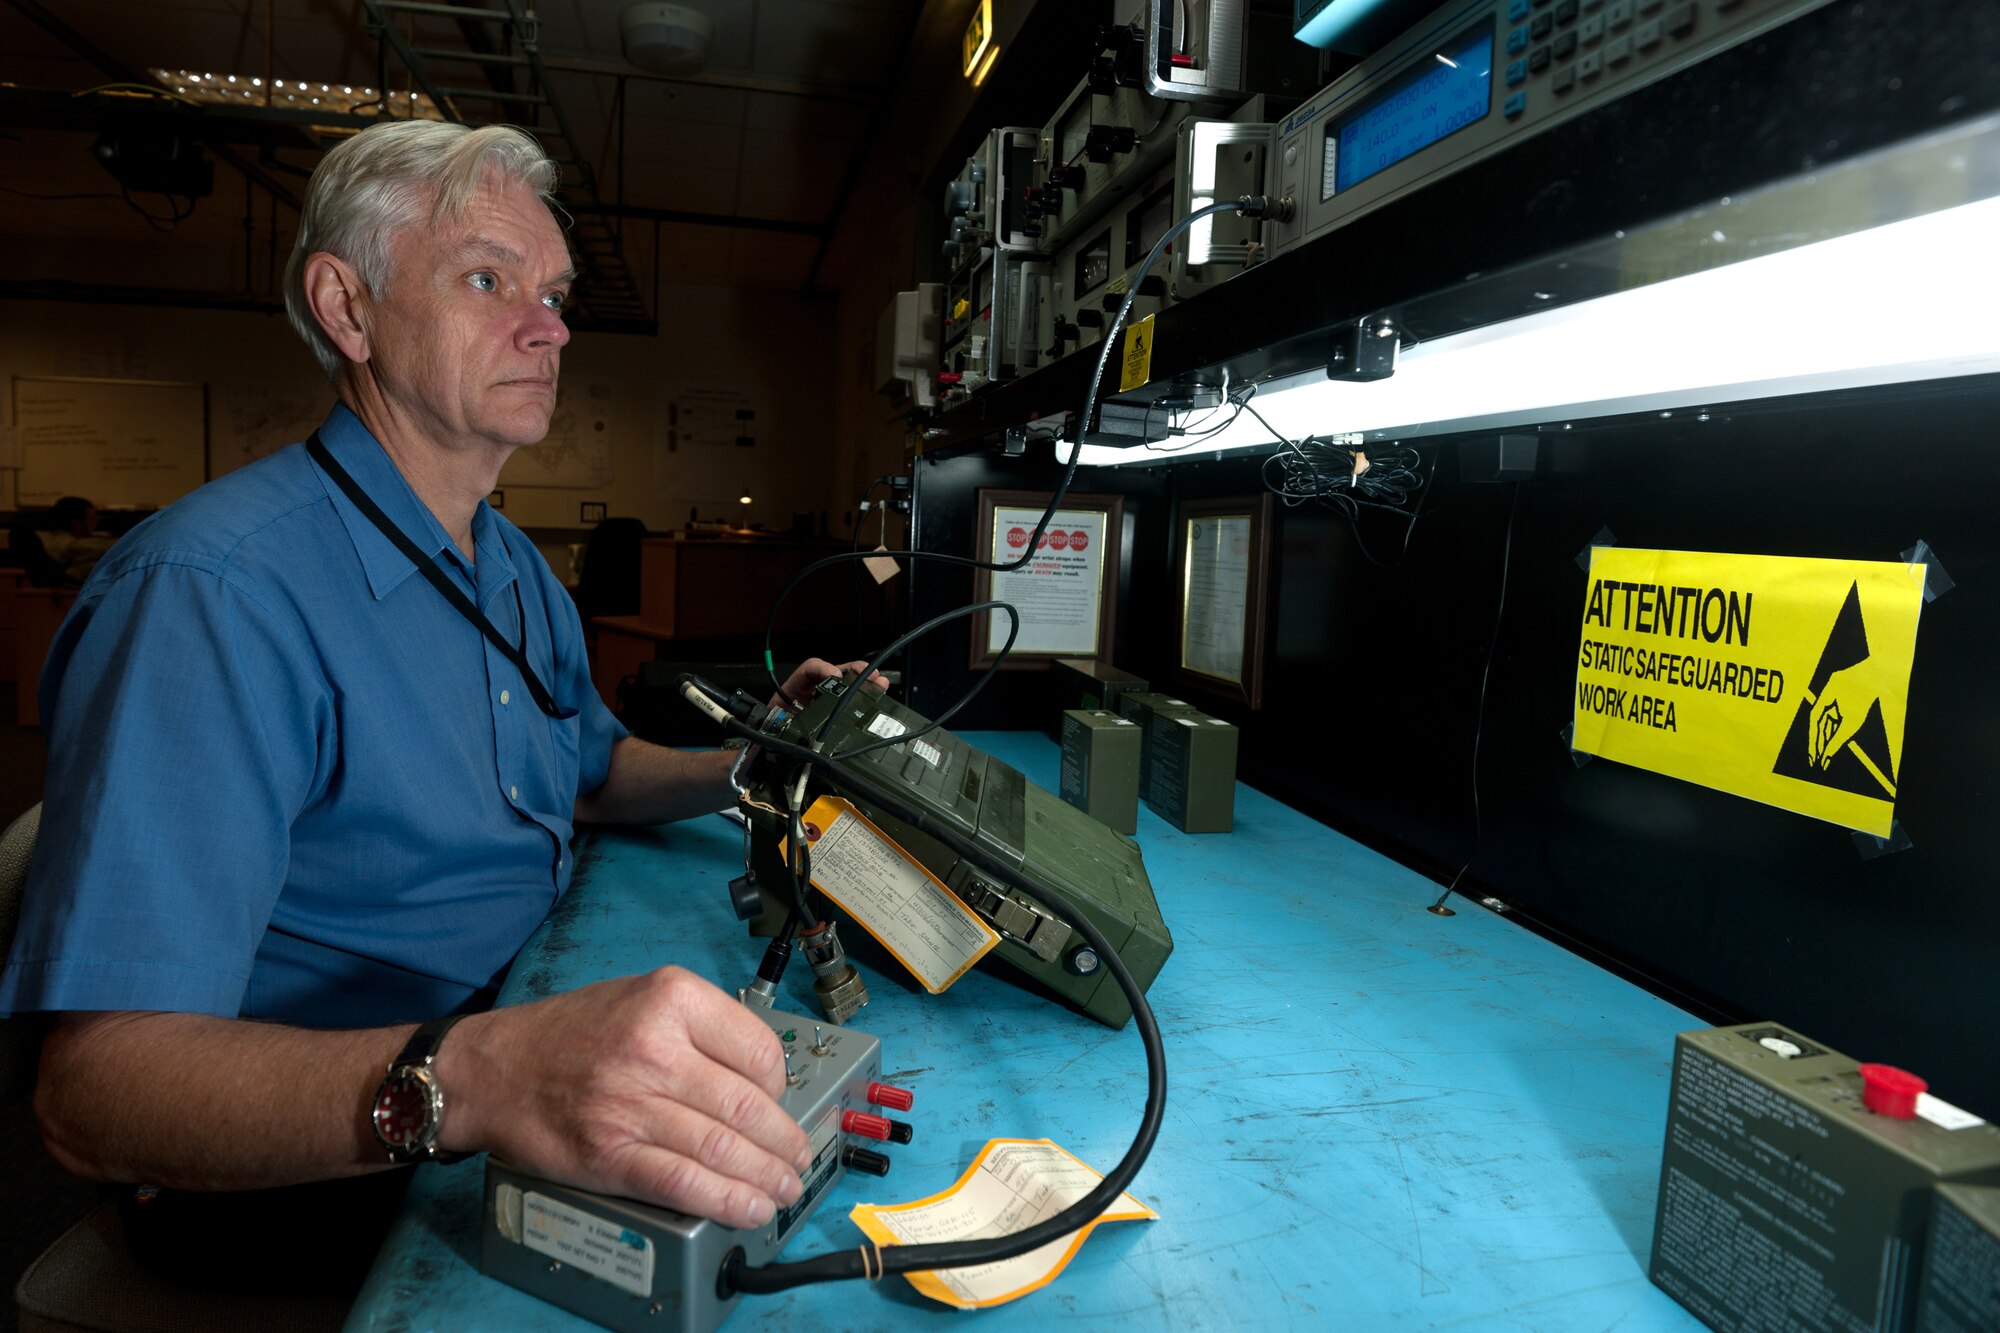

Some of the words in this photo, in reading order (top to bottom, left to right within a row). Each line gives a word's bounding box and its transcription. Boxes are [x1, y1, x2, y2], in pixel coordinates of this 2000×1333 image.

[1008, 533, 1026, 542] STOP
[1029, 535, 1048, 543] SOP
[1049, 536, 1068, 544] STOP
[1071, 537, 1088, 545] STOP
[1585, 579, 1752, 647] ATTENTION
[1581, 640, 1634, 677] STATIC
[1634, 649, 1784, 704] SAFEGUARDED
[1578, 682, 1627, 718] WORK
[1628, 695, 1677, 732] AREA
